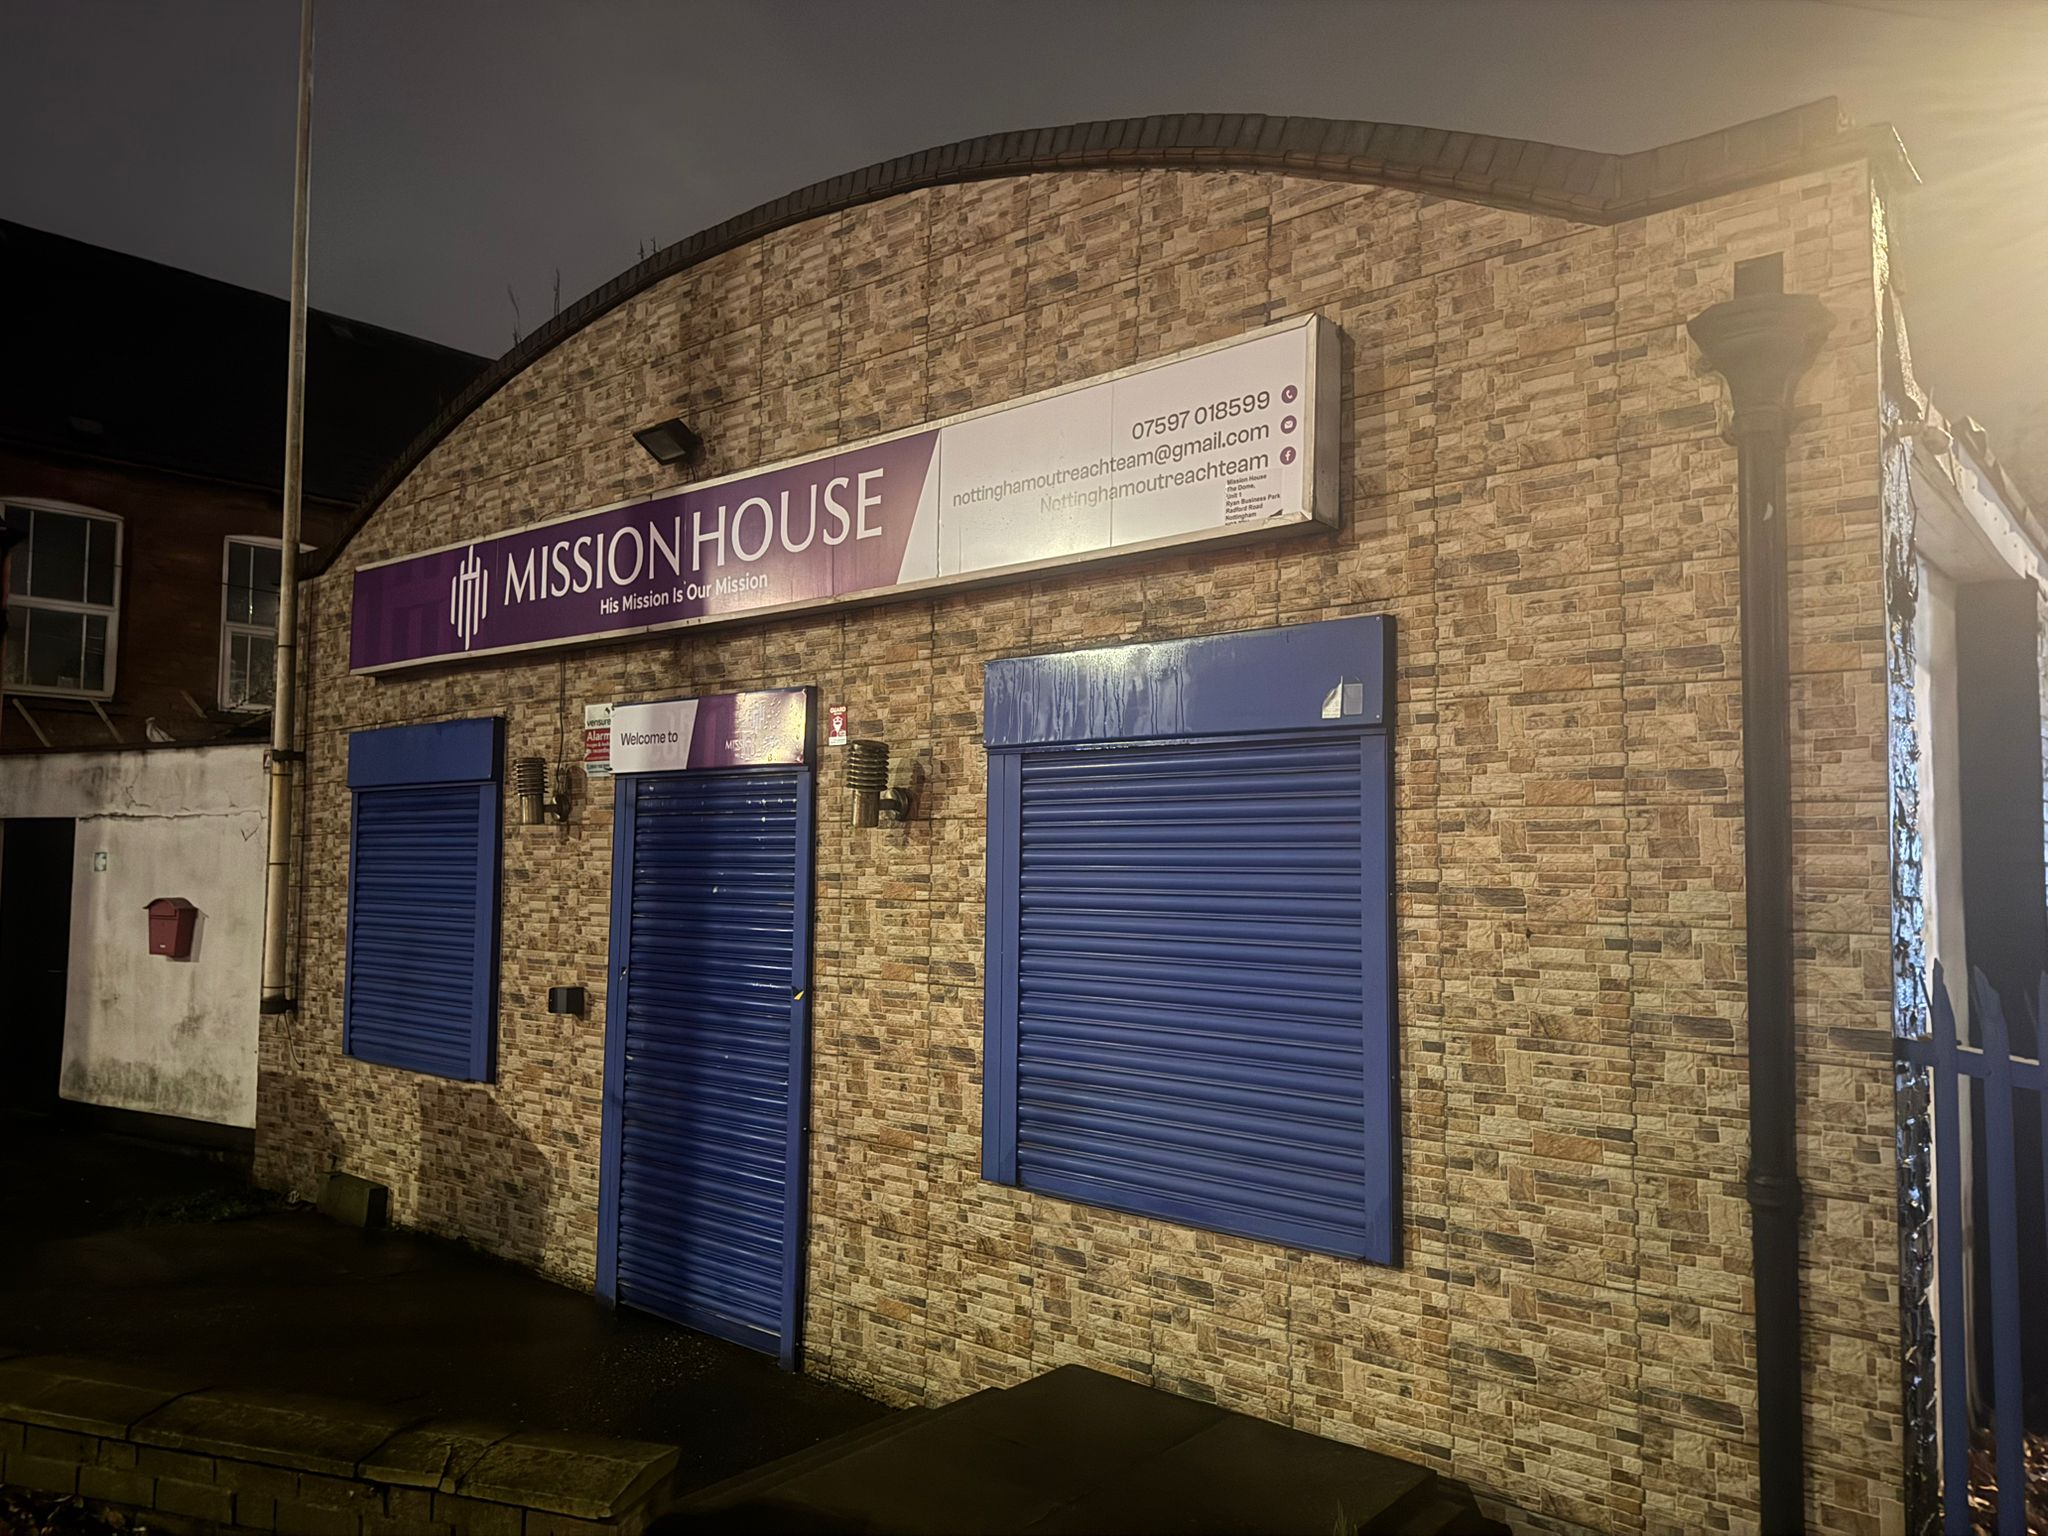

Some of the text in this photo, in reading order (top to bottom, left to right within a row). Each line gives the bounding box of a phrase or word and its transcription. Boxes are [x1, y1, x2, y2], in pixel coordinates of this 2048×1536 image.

[1132, 391, 1271, 440] 07597 018599
[952, 423, 1270, 507] nottinghamoutreachteam@gmail.com
[1040, 453, 1270, 513] Nottinghamoutreachteam
[1226, 512, 1257, 521] Nottingham
[1241, 496, 1266, 504] Business
[504, 469, 884, 605] MISSION HOUSE
[600, 572, 768, 615] His Mission Is Our Mission
[621, 731, 679, 746] Welcome to
